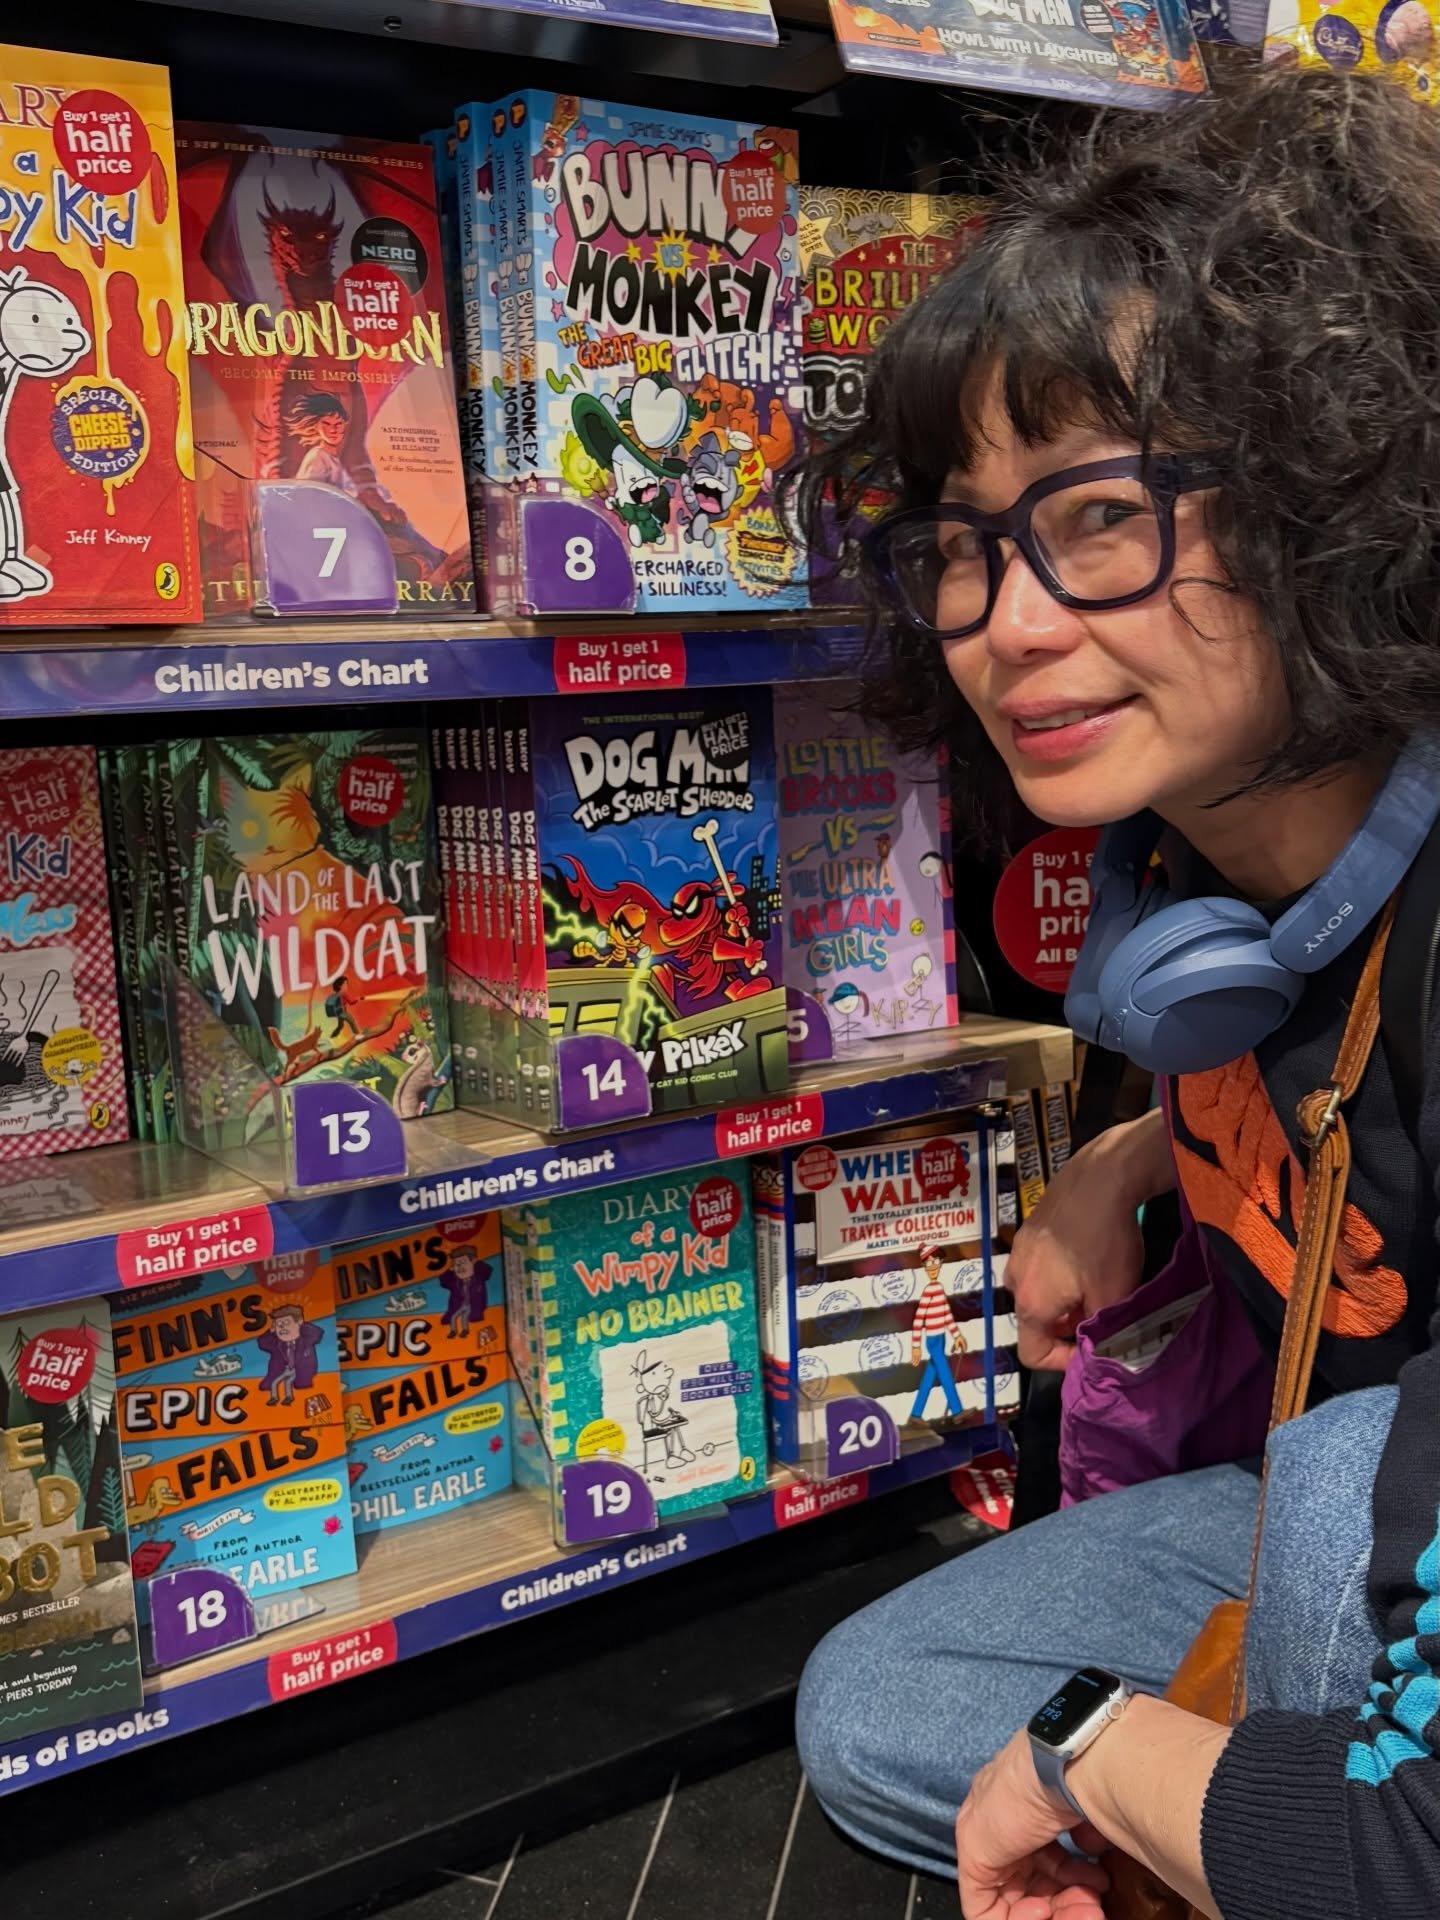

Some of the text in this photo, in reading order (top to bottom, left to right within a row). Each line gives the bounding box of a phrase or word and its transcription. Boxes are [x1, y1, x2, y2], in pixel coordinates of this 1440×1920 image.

[937, 27, 988, 48] HOWL
[989, 35, 1031, 54] WITH
[1034, 41, 1119, 67] LAUGHTER!
[63, 111, 131, 124] Buy 1 get 1
[65, 123, 132, 152] half
[15, 152, 38, 174] a
[76, 154, 132, 177] price
[383, 158, 424, 170] SERIES
[729, 167, 775, 179] Buy 1 get 1
[731, 178, 775, 201] half
[57, 174, 136, 245] Kid
[737, 203, 774, 221] price
[660, 245, 684, 268] VS
[344, 279, 399, 291] Buy 1 get 1
[566, 244, 772, 337] MONKEY
[345, 288, 399, 314] half
[353, 316, 398, 331] price
[557, 322, 785, 382] THE GREAT BIG GLITCH!
[288, 368, 315, 380] THE
[322, 370, 397, 385] IMPOSSIBLE
[464, 299, 486, 472] BUNNY MONKEY
[500, 296, 521, 471] BUNNY MONKEY
[517, 290, 539, 468] BUNNY MONKEY
[61, 389, 129, 416] SPECIAL
[69, 412, 128, 437] CHEESE
[74, 433, 131, 452] DIPPED
[70, 448, 139, 473] EDITION
[66, 529, 151, 552] Jeff Kinney
[313, 527, 347, 578] 7
[564, 536, 597, 581] 8
[648, 582, 727, 597] SILLINESS!
[578, 640, 659, 658] Buy 1 get 1
[155, 658, 428, 694] Children's Chart
[568, 660, 672, 685] half price
[703, 719, 749, 748] HALF
[710, 737, 749, 758] PRICE
[564, 731, 659, 800] DOG
[786, 737, 889, 775] LOTTIE
[11, 778, 69, 815] Half
[348, 775, 395, 801] half
[782, 773, 897, 811] BROOKS
[25, 806, 71, 829] Price
[350, 798, 388, 815] price
[573, 801, 610, 829] The
[509, 812, 524, 880] DOG MAN
[523, 811, 538, 880] DOG MAN
[825, 815, 858, 857] VS
[9, 833, 71, 882] Kid
[1032, 852, 1066, 869] Buy
[1071, 851, 1079, 864] 1
[318, 867, 336, 887] OF
[823, 858, 895, 898] ULTRA
[1034, 869, 1090, 909] ha
[203, 869, 311, 924] LAND
[344, 860, 424, 909] LAST
[312, 892, 339, 912] THE
[791, 898, 900, 942] MEAN
[1306, 902, 1353, 954] SONY
[208, 915, 436, 1006] WILDCAT
[809, 931, 889, 974] GIRLS
[1035, 948, 1061, 963] All
[582, 1059, 626, 1101] 14
[656, 1080, 672, 1088] CAT
[674, 1077, 688, 1087] KID
[690, 1072, 716, 1083] COMIC
[718, 1069, 738, 1078] CLUB
[736, 1101, 801, 1126] Buy 1 get 1
[1012, 1103, 1037, 1146] NIGHT
[321, 1110, 371, 1155] 13
[727, 1119, 812, 1148] half price
[922, 1153, 956, 1176] half
[1018, 1148, 1041, 1182] BUS
[400, 1149, 615, 1213] Children's Chart
[925, 1173, 954, 1188] price
[696, 1193, 733, 1219] half
[852, 1201, 964, 1224] THE TOTALLY ESSENTIAL
[146, 1217, 241, 1248] Buy 1 get 1
[631, 1221, 676, 1247] of a
[702, 1212, 732, 1231] price
[840, 1208, 975, 1244] TRAVEL COLLECTION
[866, 1230, 949, 1250] MARTIN HANDFORD
[135, 1236, 257, 1276] half price
[337, 1236, 447, 1299] INN'S
[573, 1232, 730, 1297] Wimpy Kid
[266, 1269, 304, 1286] price
[575, 1308, 624, 1345] NO
[627, 1280, 745, 1334] BRAINER
[37, 1338, 55, 1350] Buy
[64, 1345, 81, 1356] get
[82, 1348, 88, 1356] 1
[112, 1294, 269, 1372] FINN'S
[29, 1348, 84, 1377] half
[27, 1372, 70, 1391] price
[370, 1356, 487, 1426] FAILS
[125, 1384, 247, 1431] EPIC
[838, 1416, 882, 1454] 20
[177, 1427, 319, 1500] FAILS
[400, 1458, 431, 1472] FROM
[360, 1467, 431, 1493] BESTSELLING
[414, 1465, 487, 1510] EARLE
[587, 1481, 631, 1518] 19
[785, 1484, 858, 1519] half price
[214, 1536, 248, 1550] FROM
[254, 1535, 302, 1552] AUTHOR
[501, 1533, 687, 1610] Children's Chart
[22, 1597, 80, 1621] BESTSELLER
[177, 1589, 227, 1635] 18
[291, 1631, 371, 1666] Buy 1 get 1
[12, 1675, 31, 1688] and
[33, 1663, 78, 1682] beguiling
[282, 1646, 384, 1692] half price
[6, 1676, 73, 1702] PIERS TORDAY
[36, 1708, 170, 1767] of Books
